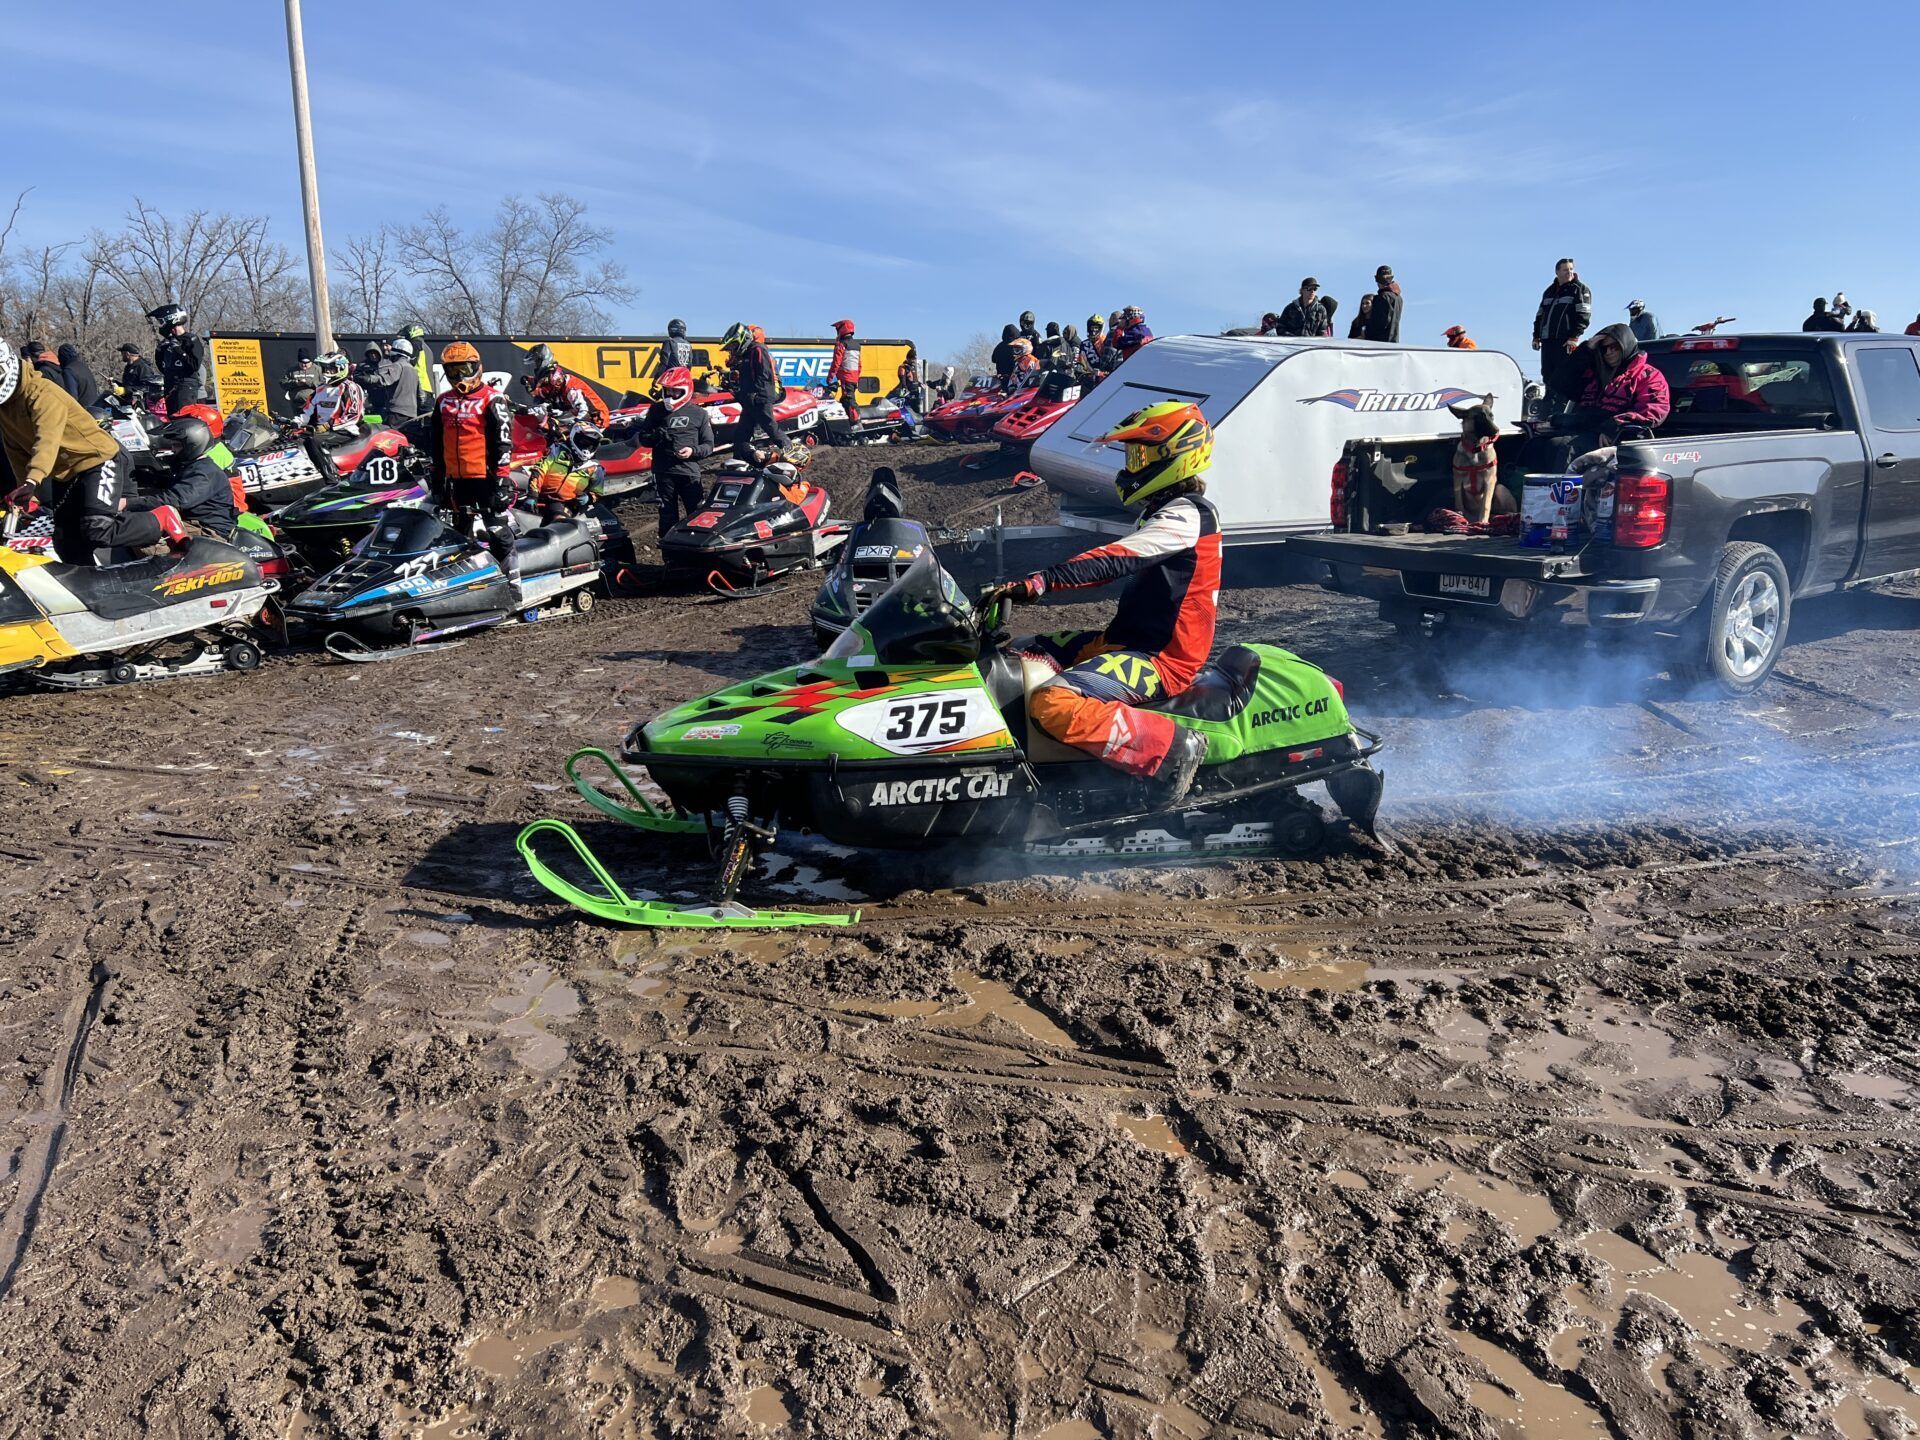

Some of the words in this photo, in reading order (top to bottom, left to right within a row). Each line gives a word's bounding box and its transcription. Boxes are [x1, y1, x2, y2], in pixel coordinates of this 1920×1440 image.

[1354, 389, 1443, 412] TRITON
[800, 411, 815, 425] 107
[260, 451, 285, 463] 700
[367, 457, 399, 485] 18
[1551, 481, 1574, 504] VP
[8, 537, 53, 549] 700
[855, 546, 893, 558] FXR
[886, 699, 968, 741] 375
[1251, 704, 1301, 728] ARCTIC
[1304, 697, 1330, 716] CAT
[869, 776, 961, 807] ARCTIC
[967, 773, 1014, 799] CAT
